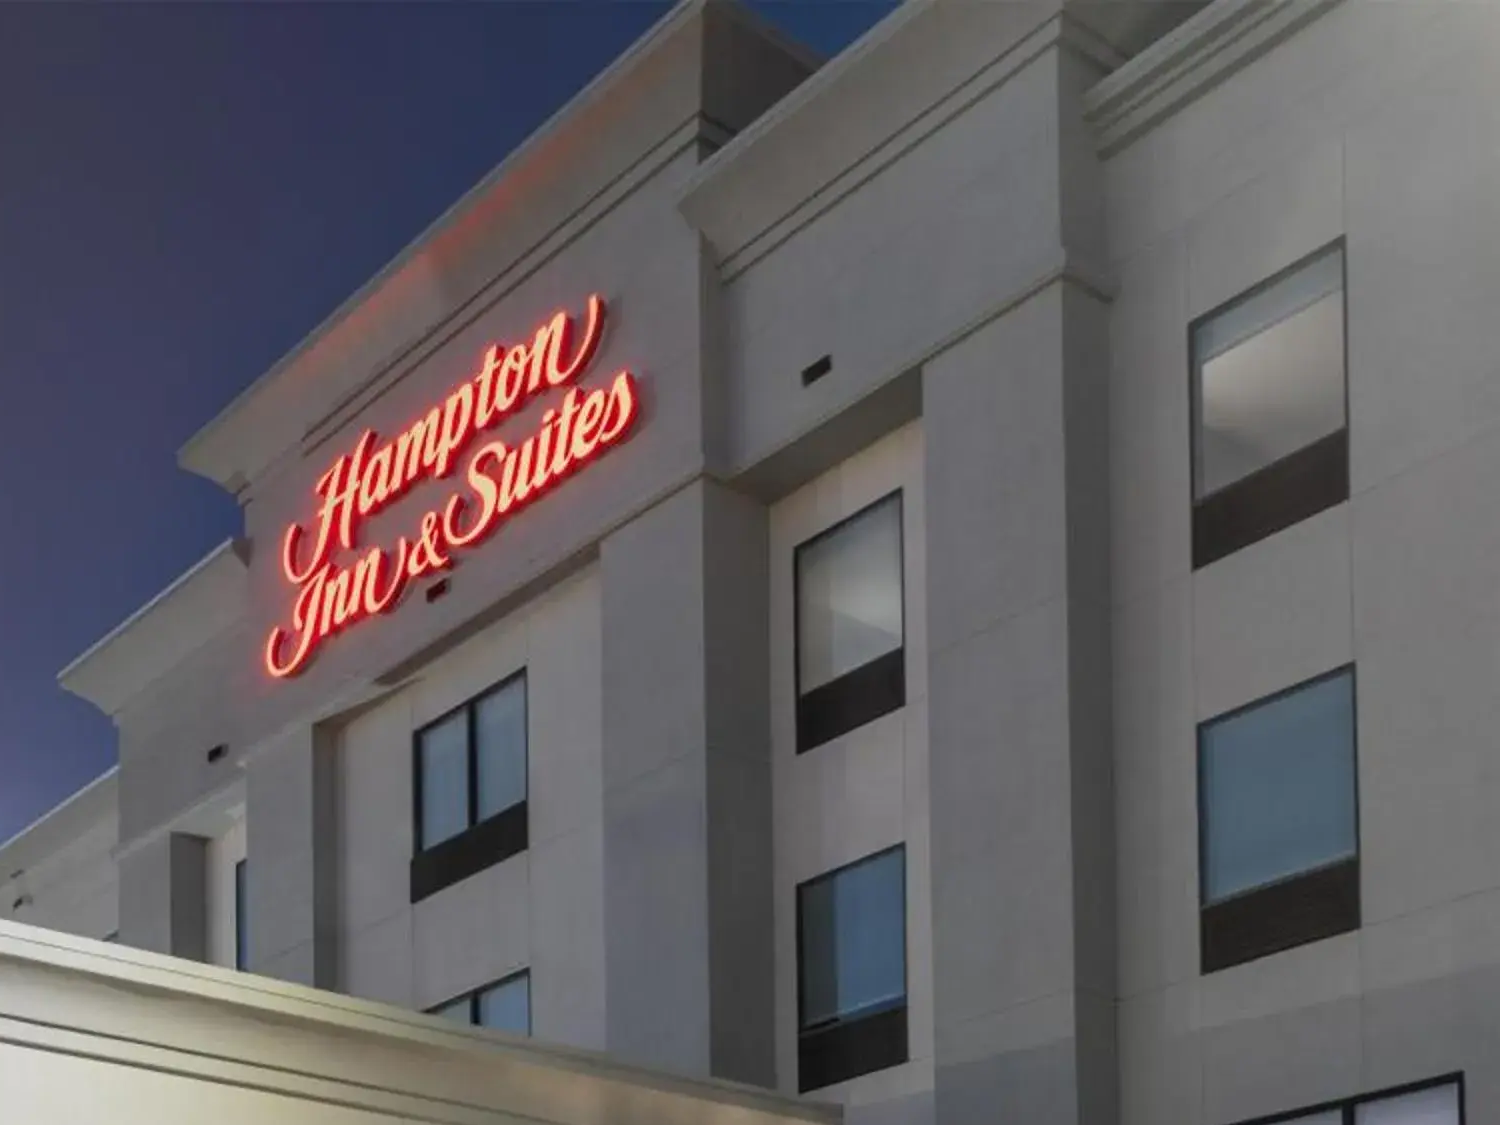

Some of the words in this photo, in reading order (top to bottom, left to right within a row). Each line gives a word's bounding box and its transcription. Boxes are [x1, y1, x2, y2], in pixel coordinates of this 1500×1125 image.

[265, 537, 407, 678] Inn
[408, 510, 452, 577] &
[445, 369, 638, 546] Suites
[284, 292, 605, 585] Hampton
